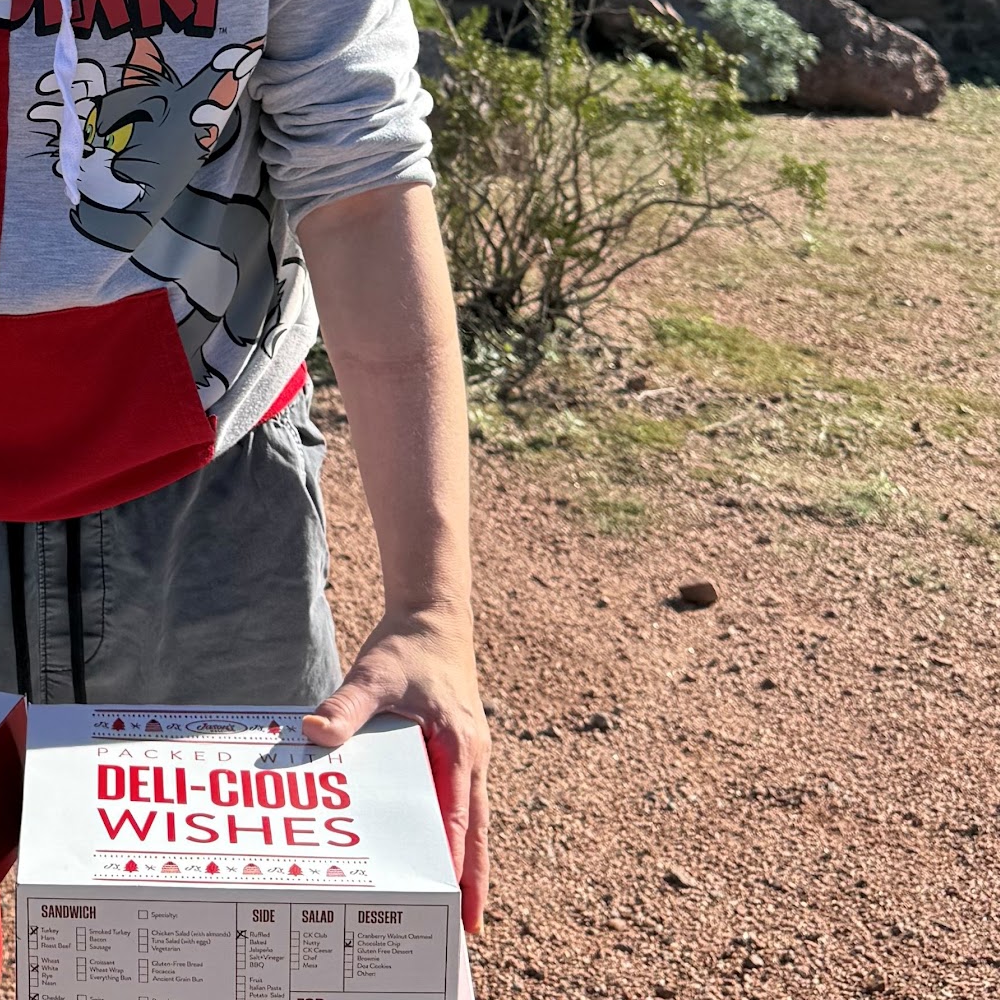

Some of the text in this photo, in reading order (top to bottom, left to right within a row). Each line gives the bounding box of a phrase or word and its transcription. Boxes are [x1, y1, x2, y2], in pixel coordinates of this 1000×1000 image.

[97, 747, 343, 764] PACKED WITH
[97, 764, 351, 810] DELI-CIOUS
[97, 807, 361, 847] WISHES
[41, 904, 97, 919] SANDWICH
[252, 909, 276, 923] SIDE
[301, 909, 335, 924] SALAD
[357, 910, 404, 925] DESSERT
[41, 927, 59, 936] Turkey
[89, 928, 131, 937] Smoked Turkey
[357, 932, 386, 940] Cranberry
[89, 944, 112, 952] Sausage
[89, 974, 120, 983] Everything
